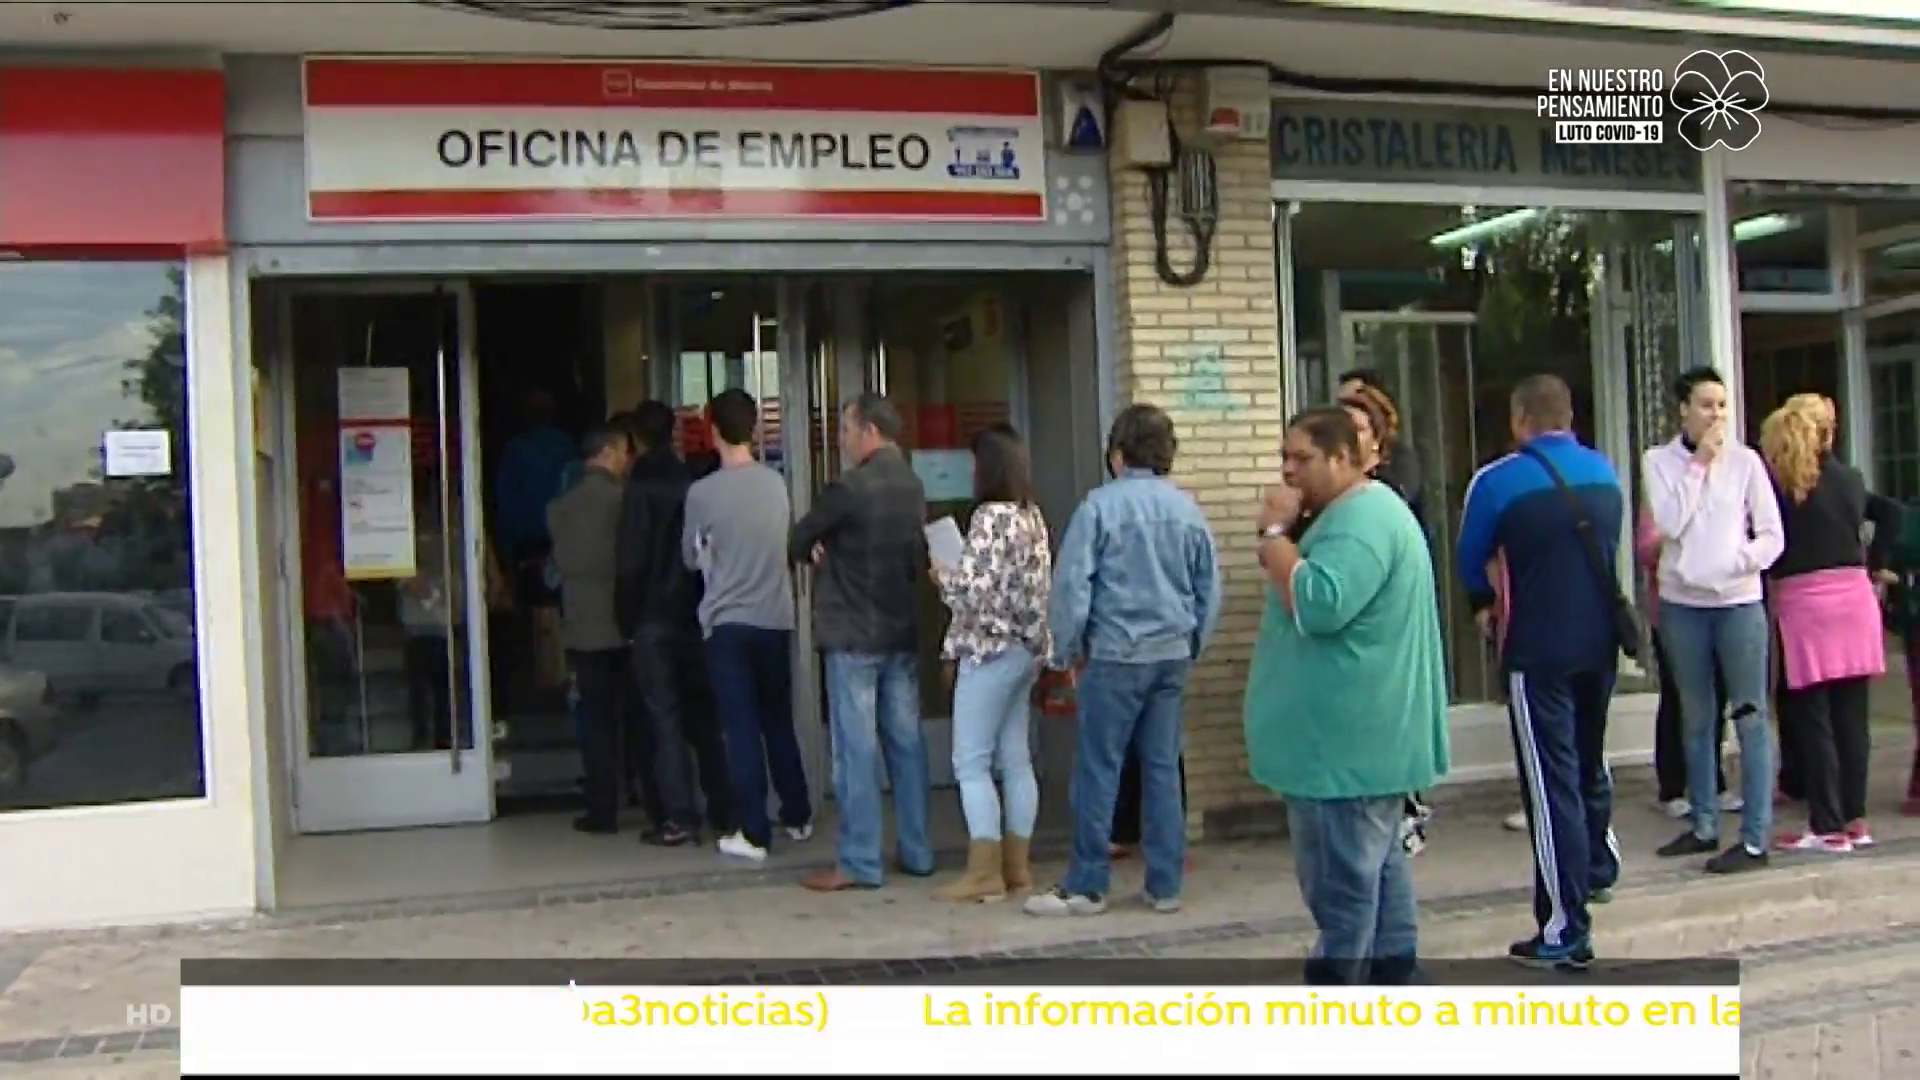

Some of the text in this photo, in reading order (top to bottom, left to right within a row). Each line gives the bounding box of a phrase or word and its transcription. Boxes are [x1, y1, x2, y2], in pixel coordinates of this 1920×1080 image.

[436, 129, 931, 171] OFICINA DE EMPLEO
[1277, 114, 1517, 174] CRISTALERIA
